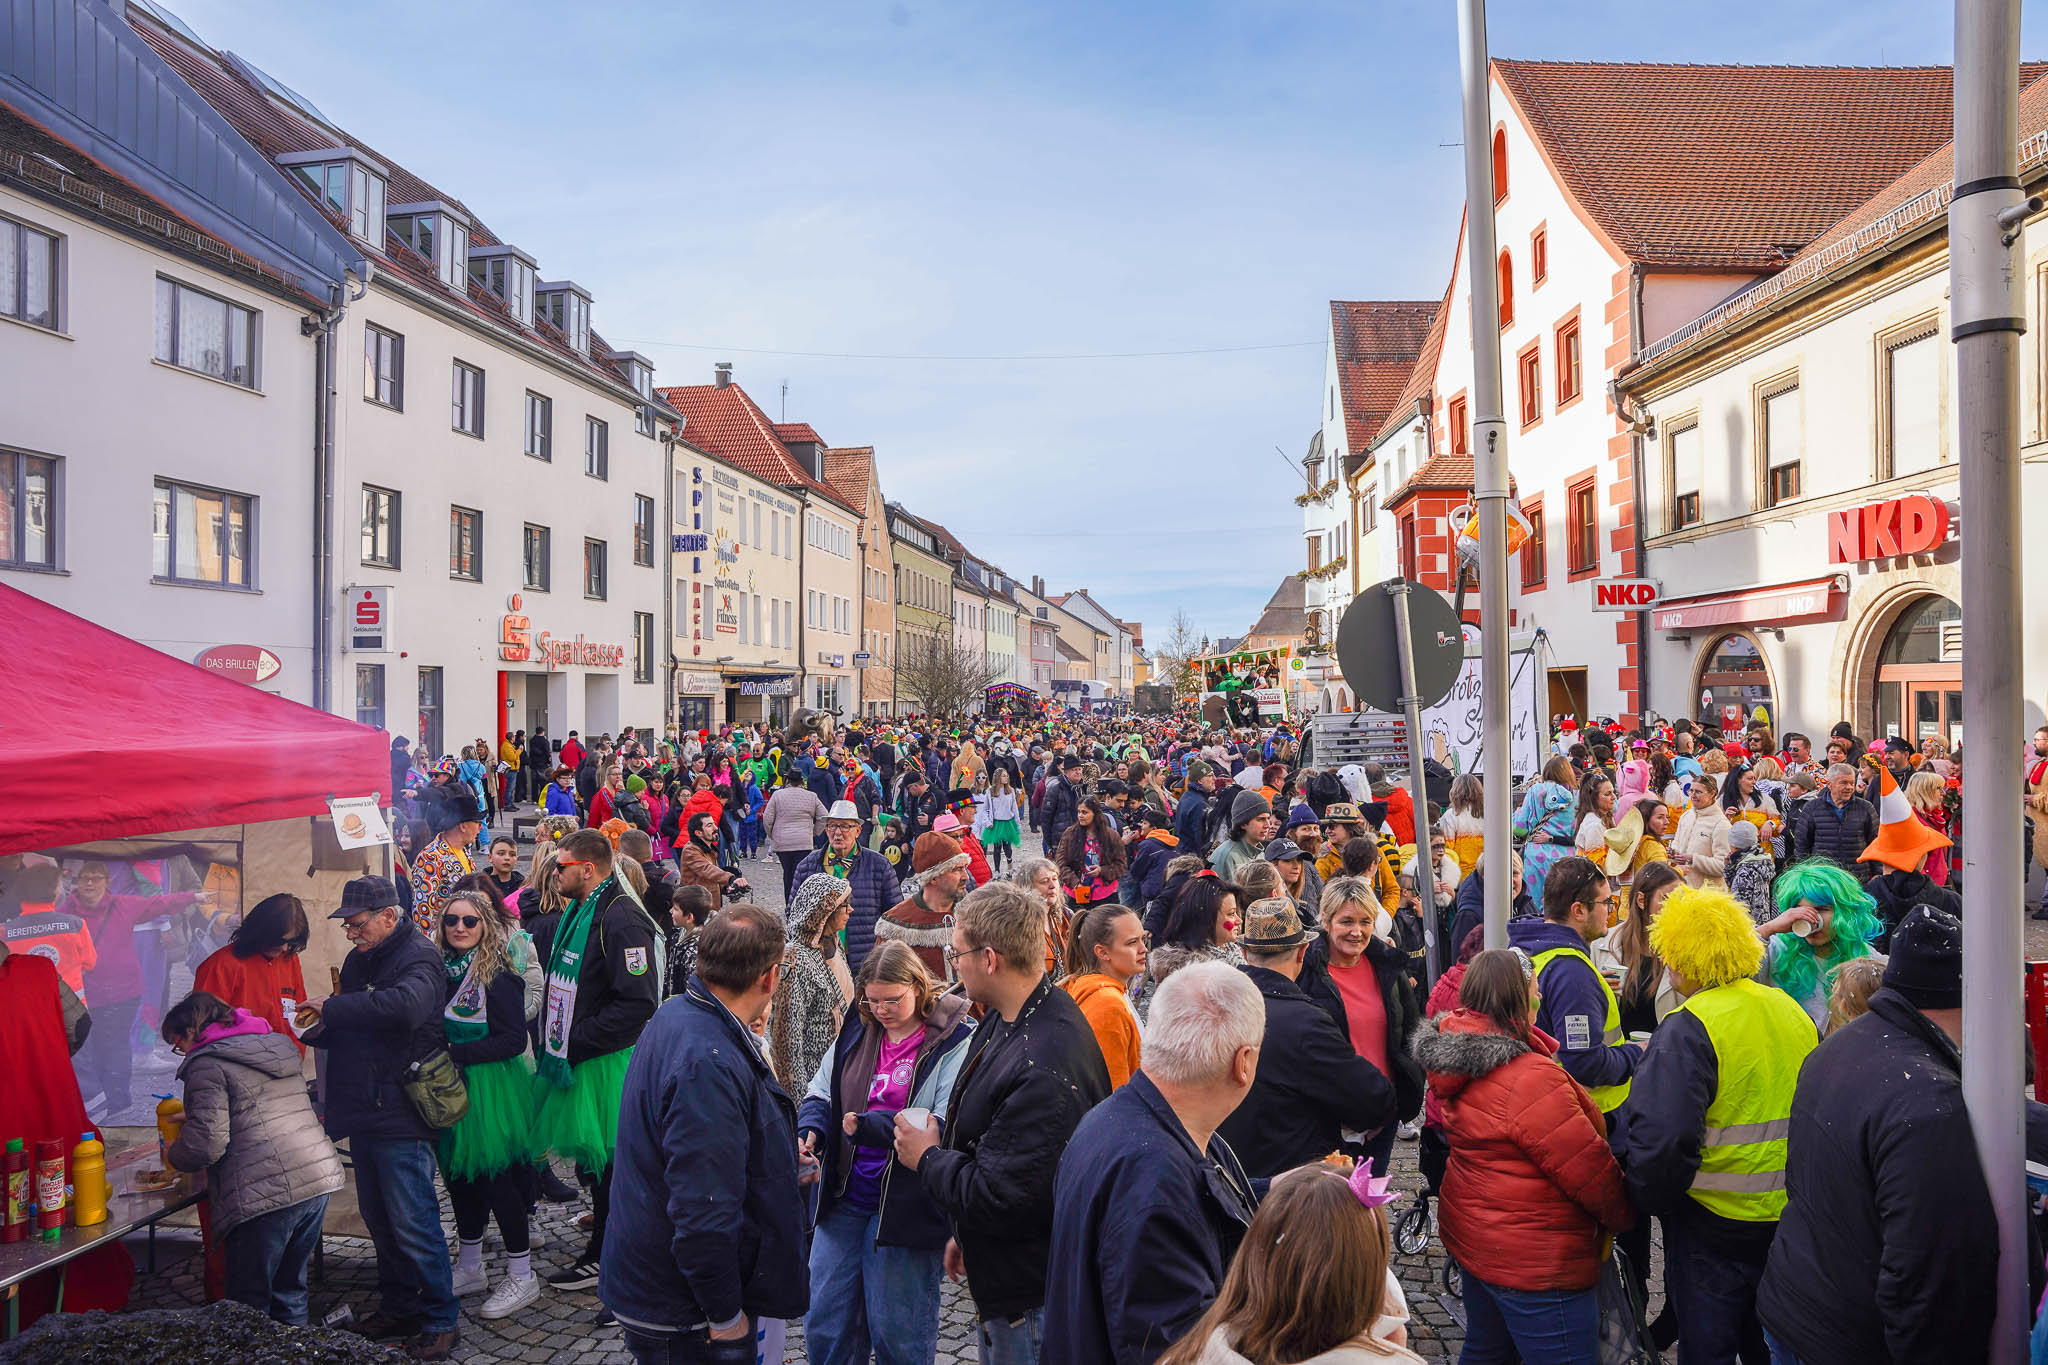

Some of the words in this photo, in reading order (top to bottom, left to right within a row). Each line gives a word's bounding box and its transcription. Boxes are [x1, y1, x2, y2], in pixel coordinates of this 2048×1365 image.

[1828, 495, 1950, 564] NKD
[672, 535, 708, 552] CENTER
[1598, 584, 1656, 605] NKD
[1786, 597, 1814, 613] NKD
[716, 608, 737, 625] Fitness
[1662, 613, 1682, 627] NKD
[536, 632, 624, 671] Sparkasse
[206, 658, 224, 669] DAS
[1722, 729, 1742, 743] SALE
[1334, 806, 1351, 816] DO
[7, 922, 70, 938] BEREITSCHAFTEN
